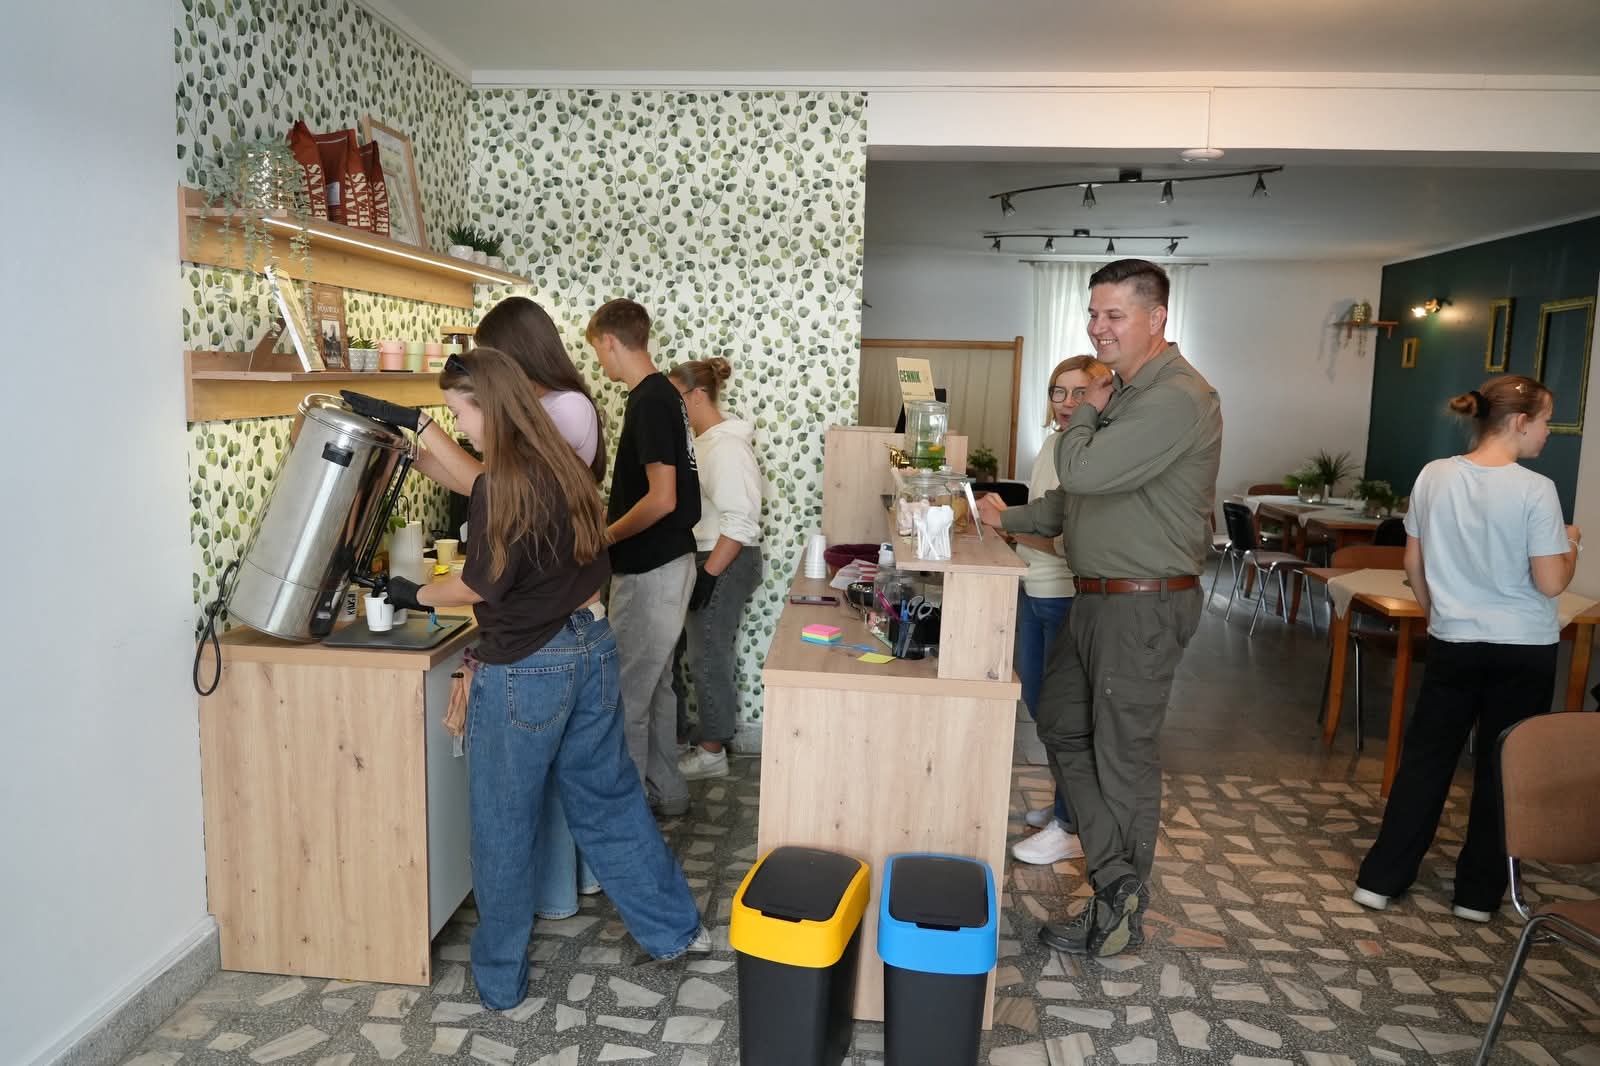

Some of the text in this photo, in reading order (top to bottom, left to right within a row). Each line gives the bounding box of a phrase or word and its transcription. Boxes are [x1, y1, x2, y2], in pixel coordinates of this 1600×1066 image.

[307, 164, 328, 220] BEANS
[352, 172, 371, 226] BEANS
[374, 181, 389, 232] BEANS
[899, 369, 921, 383] CENNIK
